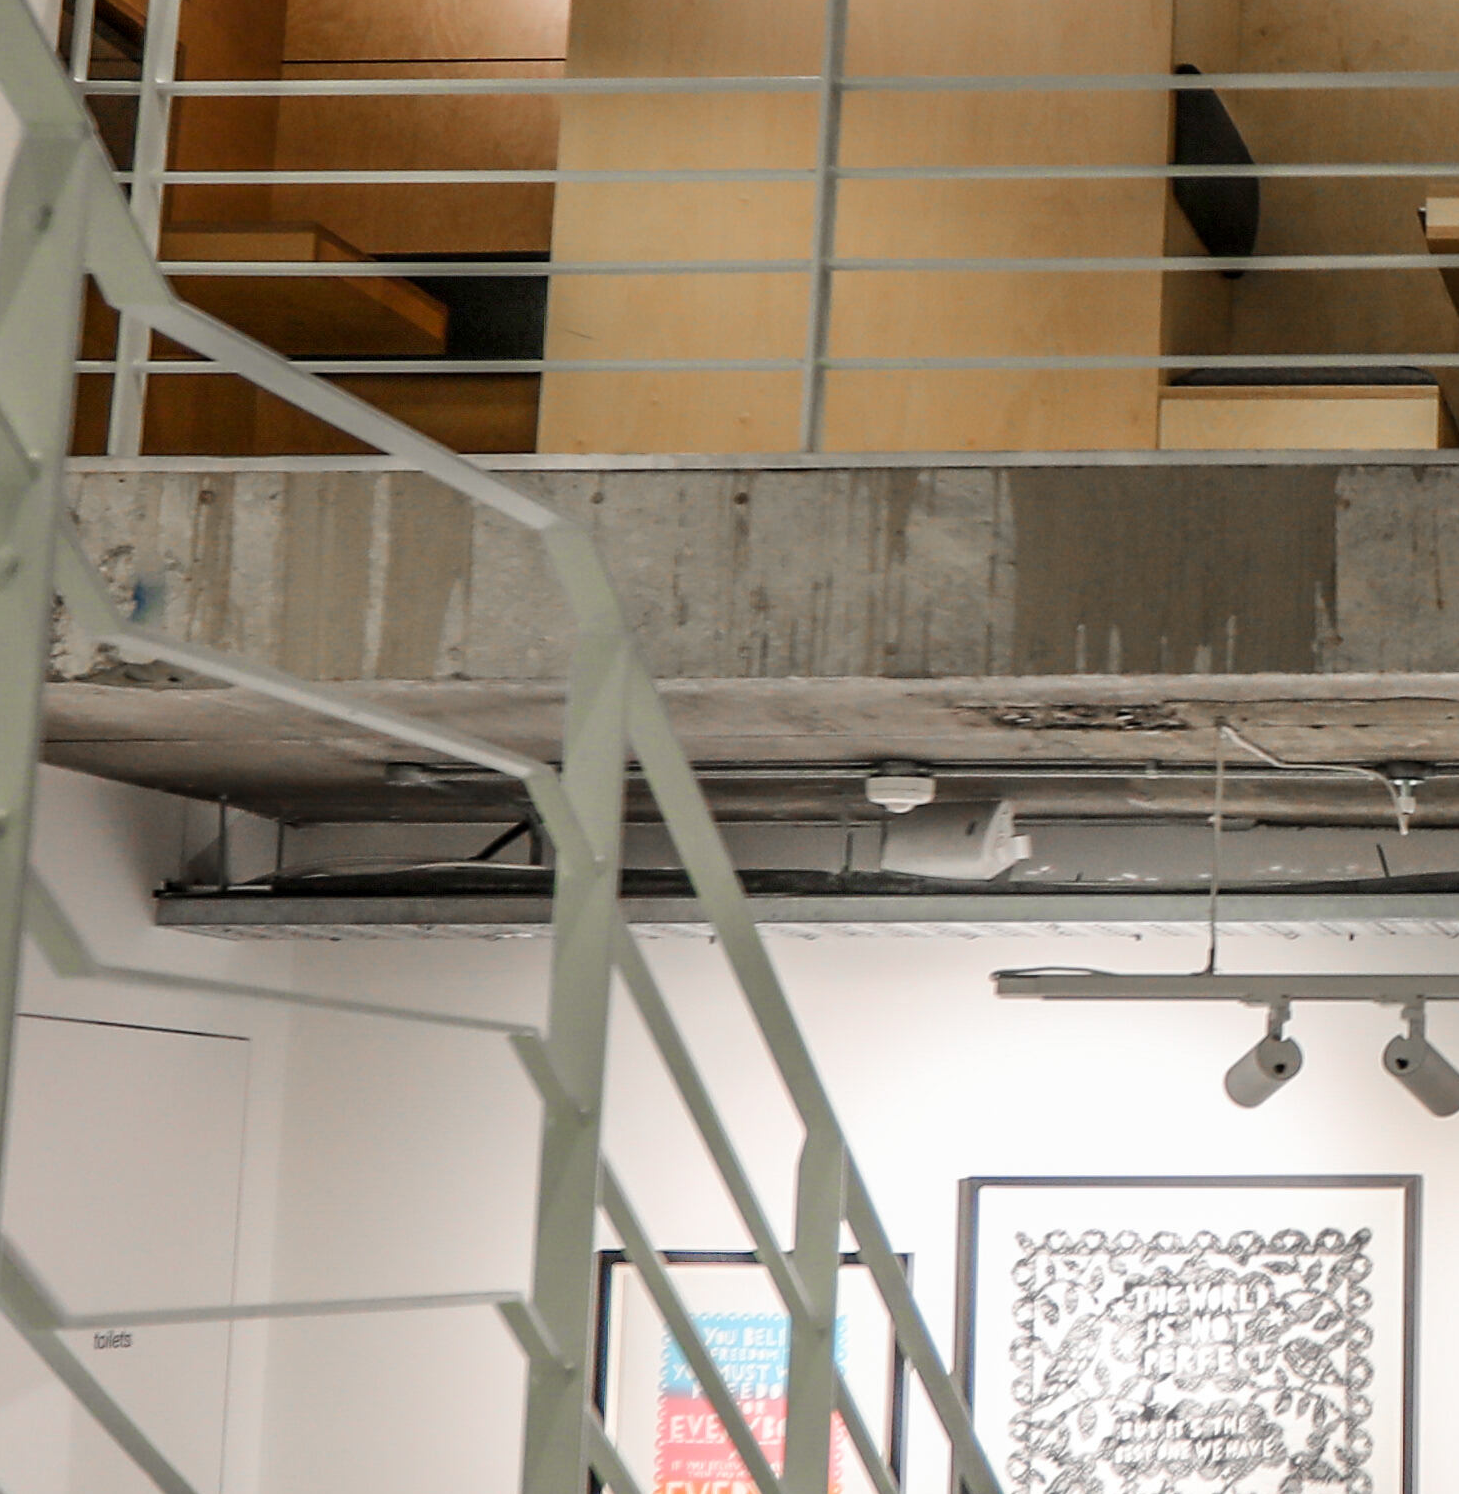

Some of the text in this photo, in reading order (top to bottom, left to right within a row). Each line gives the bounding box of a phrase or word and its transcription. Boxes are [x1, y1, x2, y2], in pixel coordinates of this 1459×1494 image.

[1186, 1283, 1269, 1313] WORLD
[1190, 1314, 1252, 1344] NOT
[1144, 1345, 1272, 1374] PERFECT
